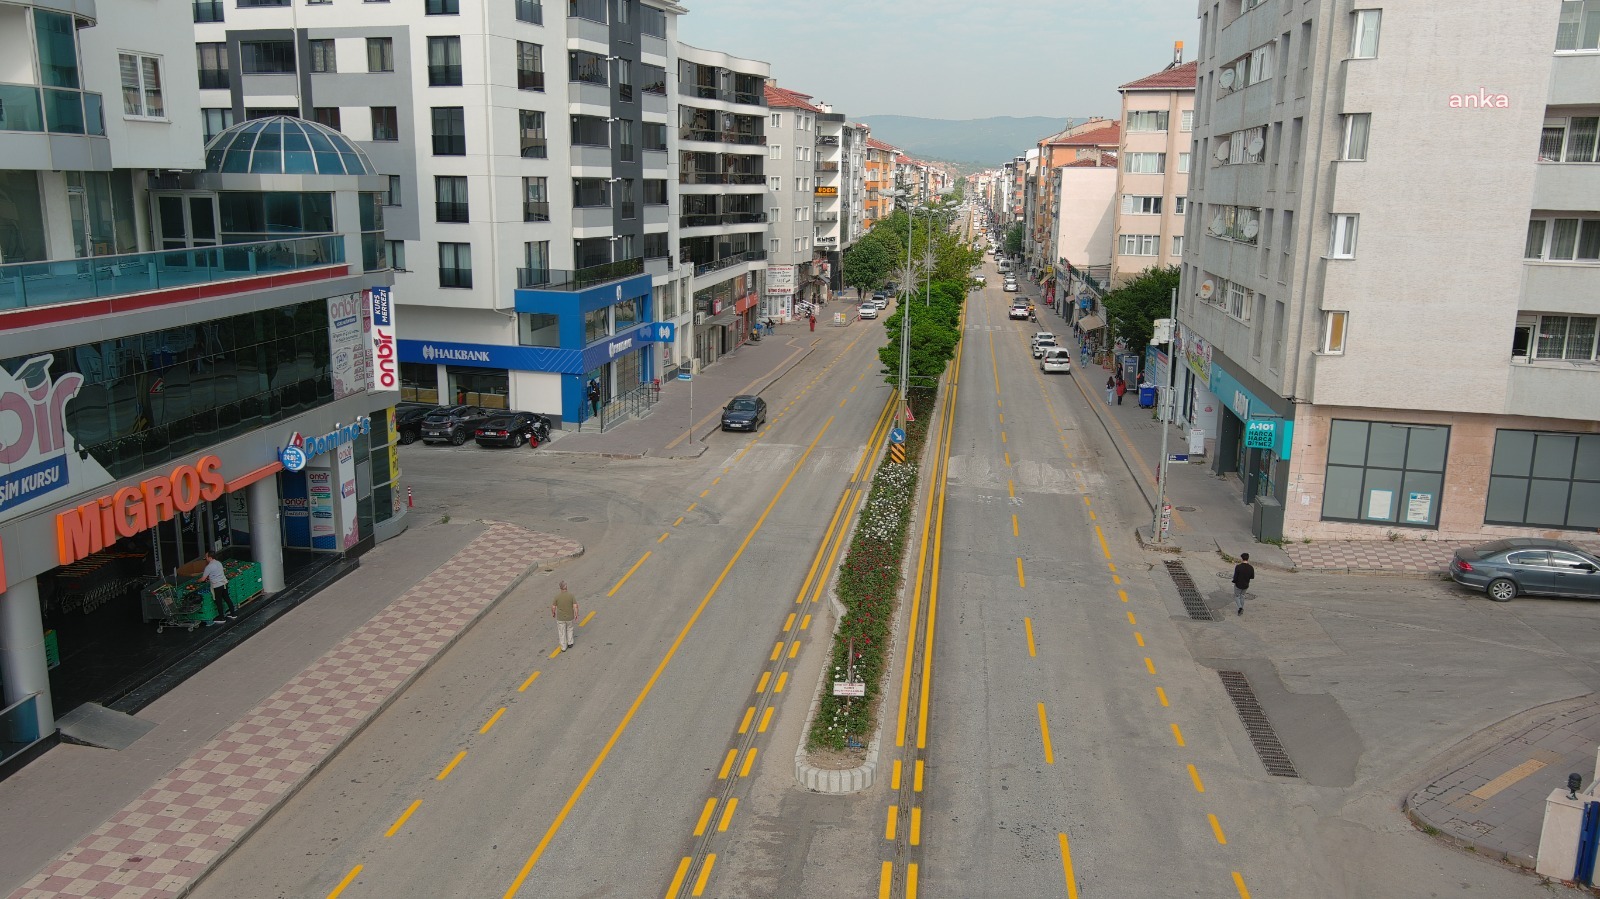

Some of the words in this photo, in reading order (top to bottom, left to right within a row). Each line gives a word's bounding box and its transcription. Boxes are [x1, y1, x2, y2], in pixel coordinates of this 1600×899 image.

[331, 297, 358, 319] onbir
[373, 294, 381, 315] KURS
[379, 289, 388, 323] MERKEZİ
[377, 328, 395, 387] onbir
[434, 348, 490, 362] HALKBANK
[304, 417, 371, 460] Domino's
[21, 465, 59, 495] KURSU
